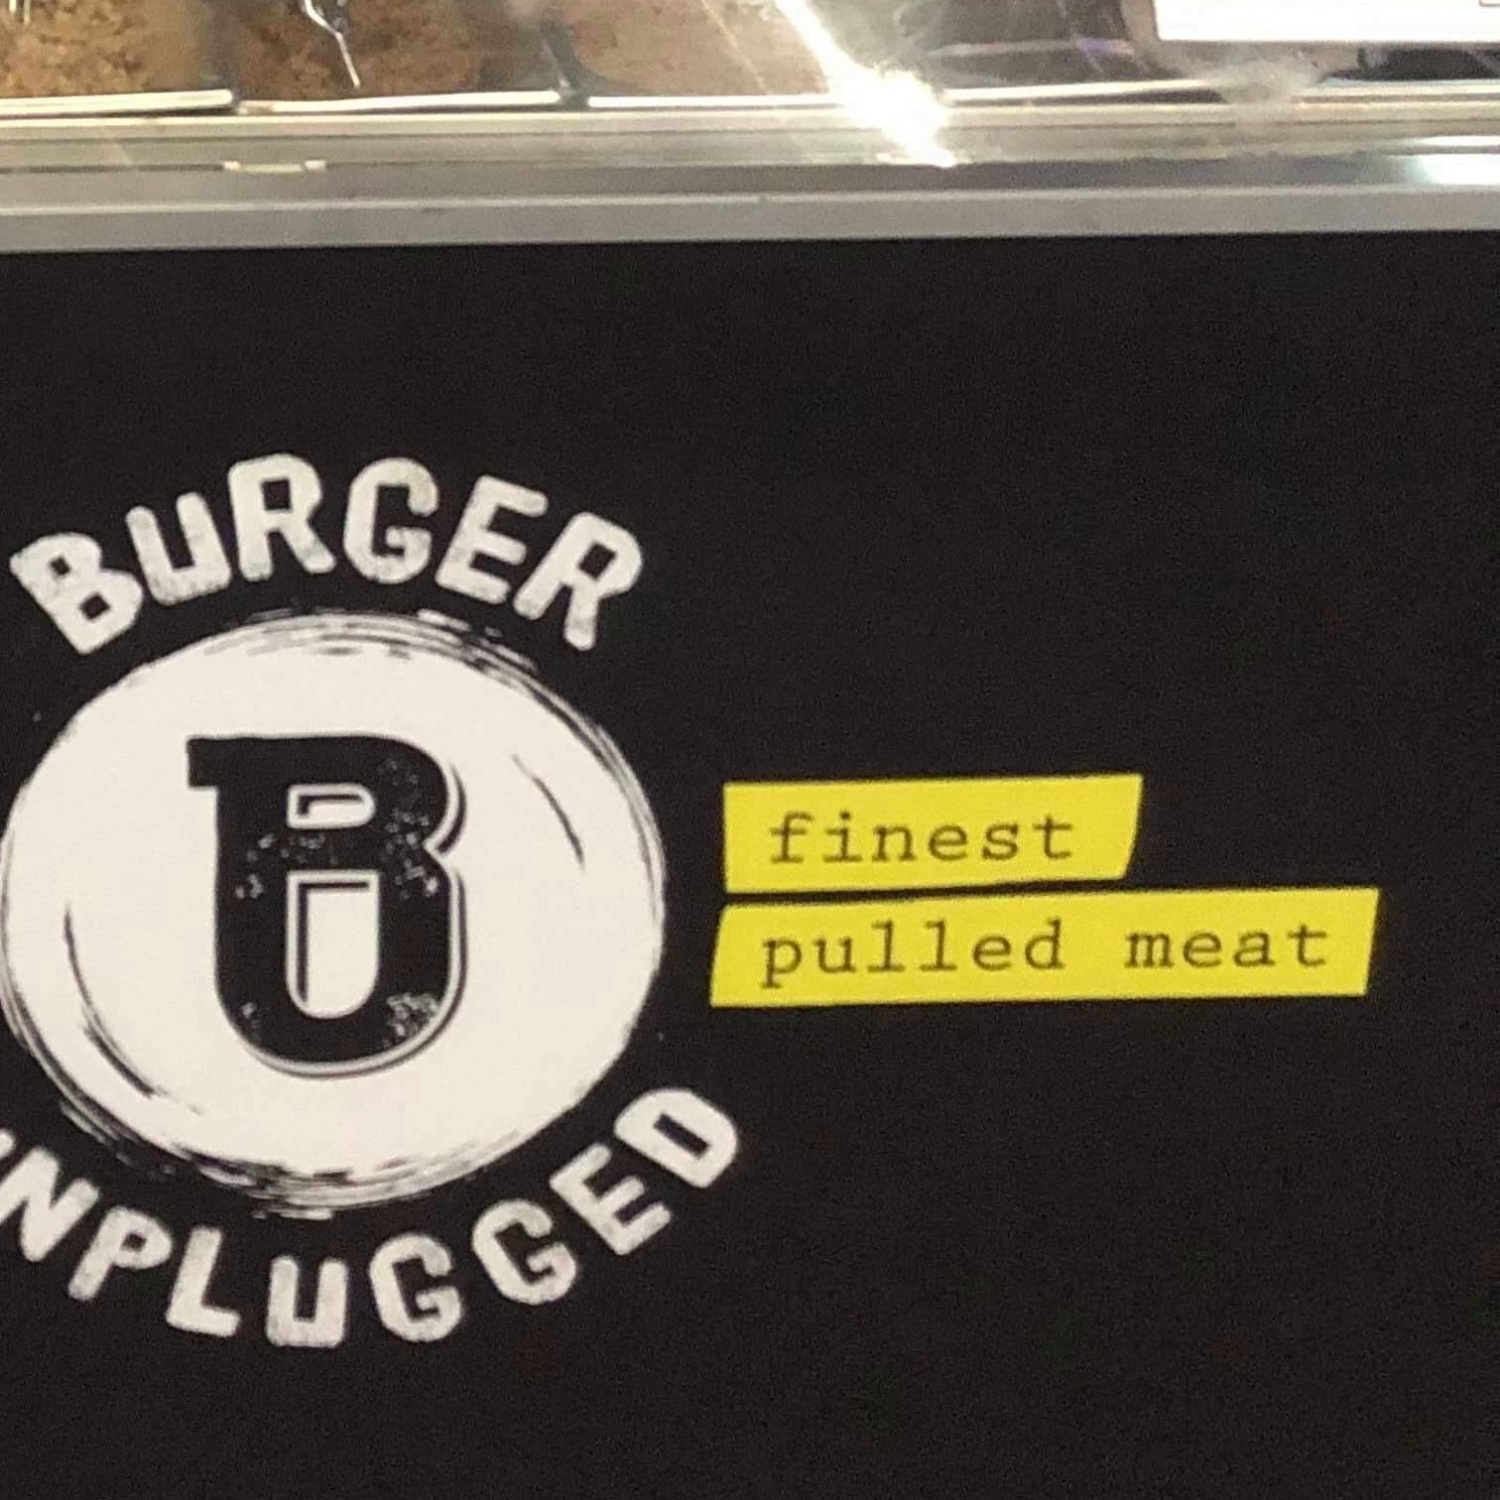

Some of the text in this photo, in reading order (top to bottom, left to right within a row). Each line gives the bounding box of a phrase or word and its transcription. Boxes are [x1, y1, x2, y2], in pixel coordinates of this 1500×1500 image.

[9, 454, 643, 654] BURGER
[769, 810, 1074, 864] finest
[760, 918, 1330, 990] pulled meat
